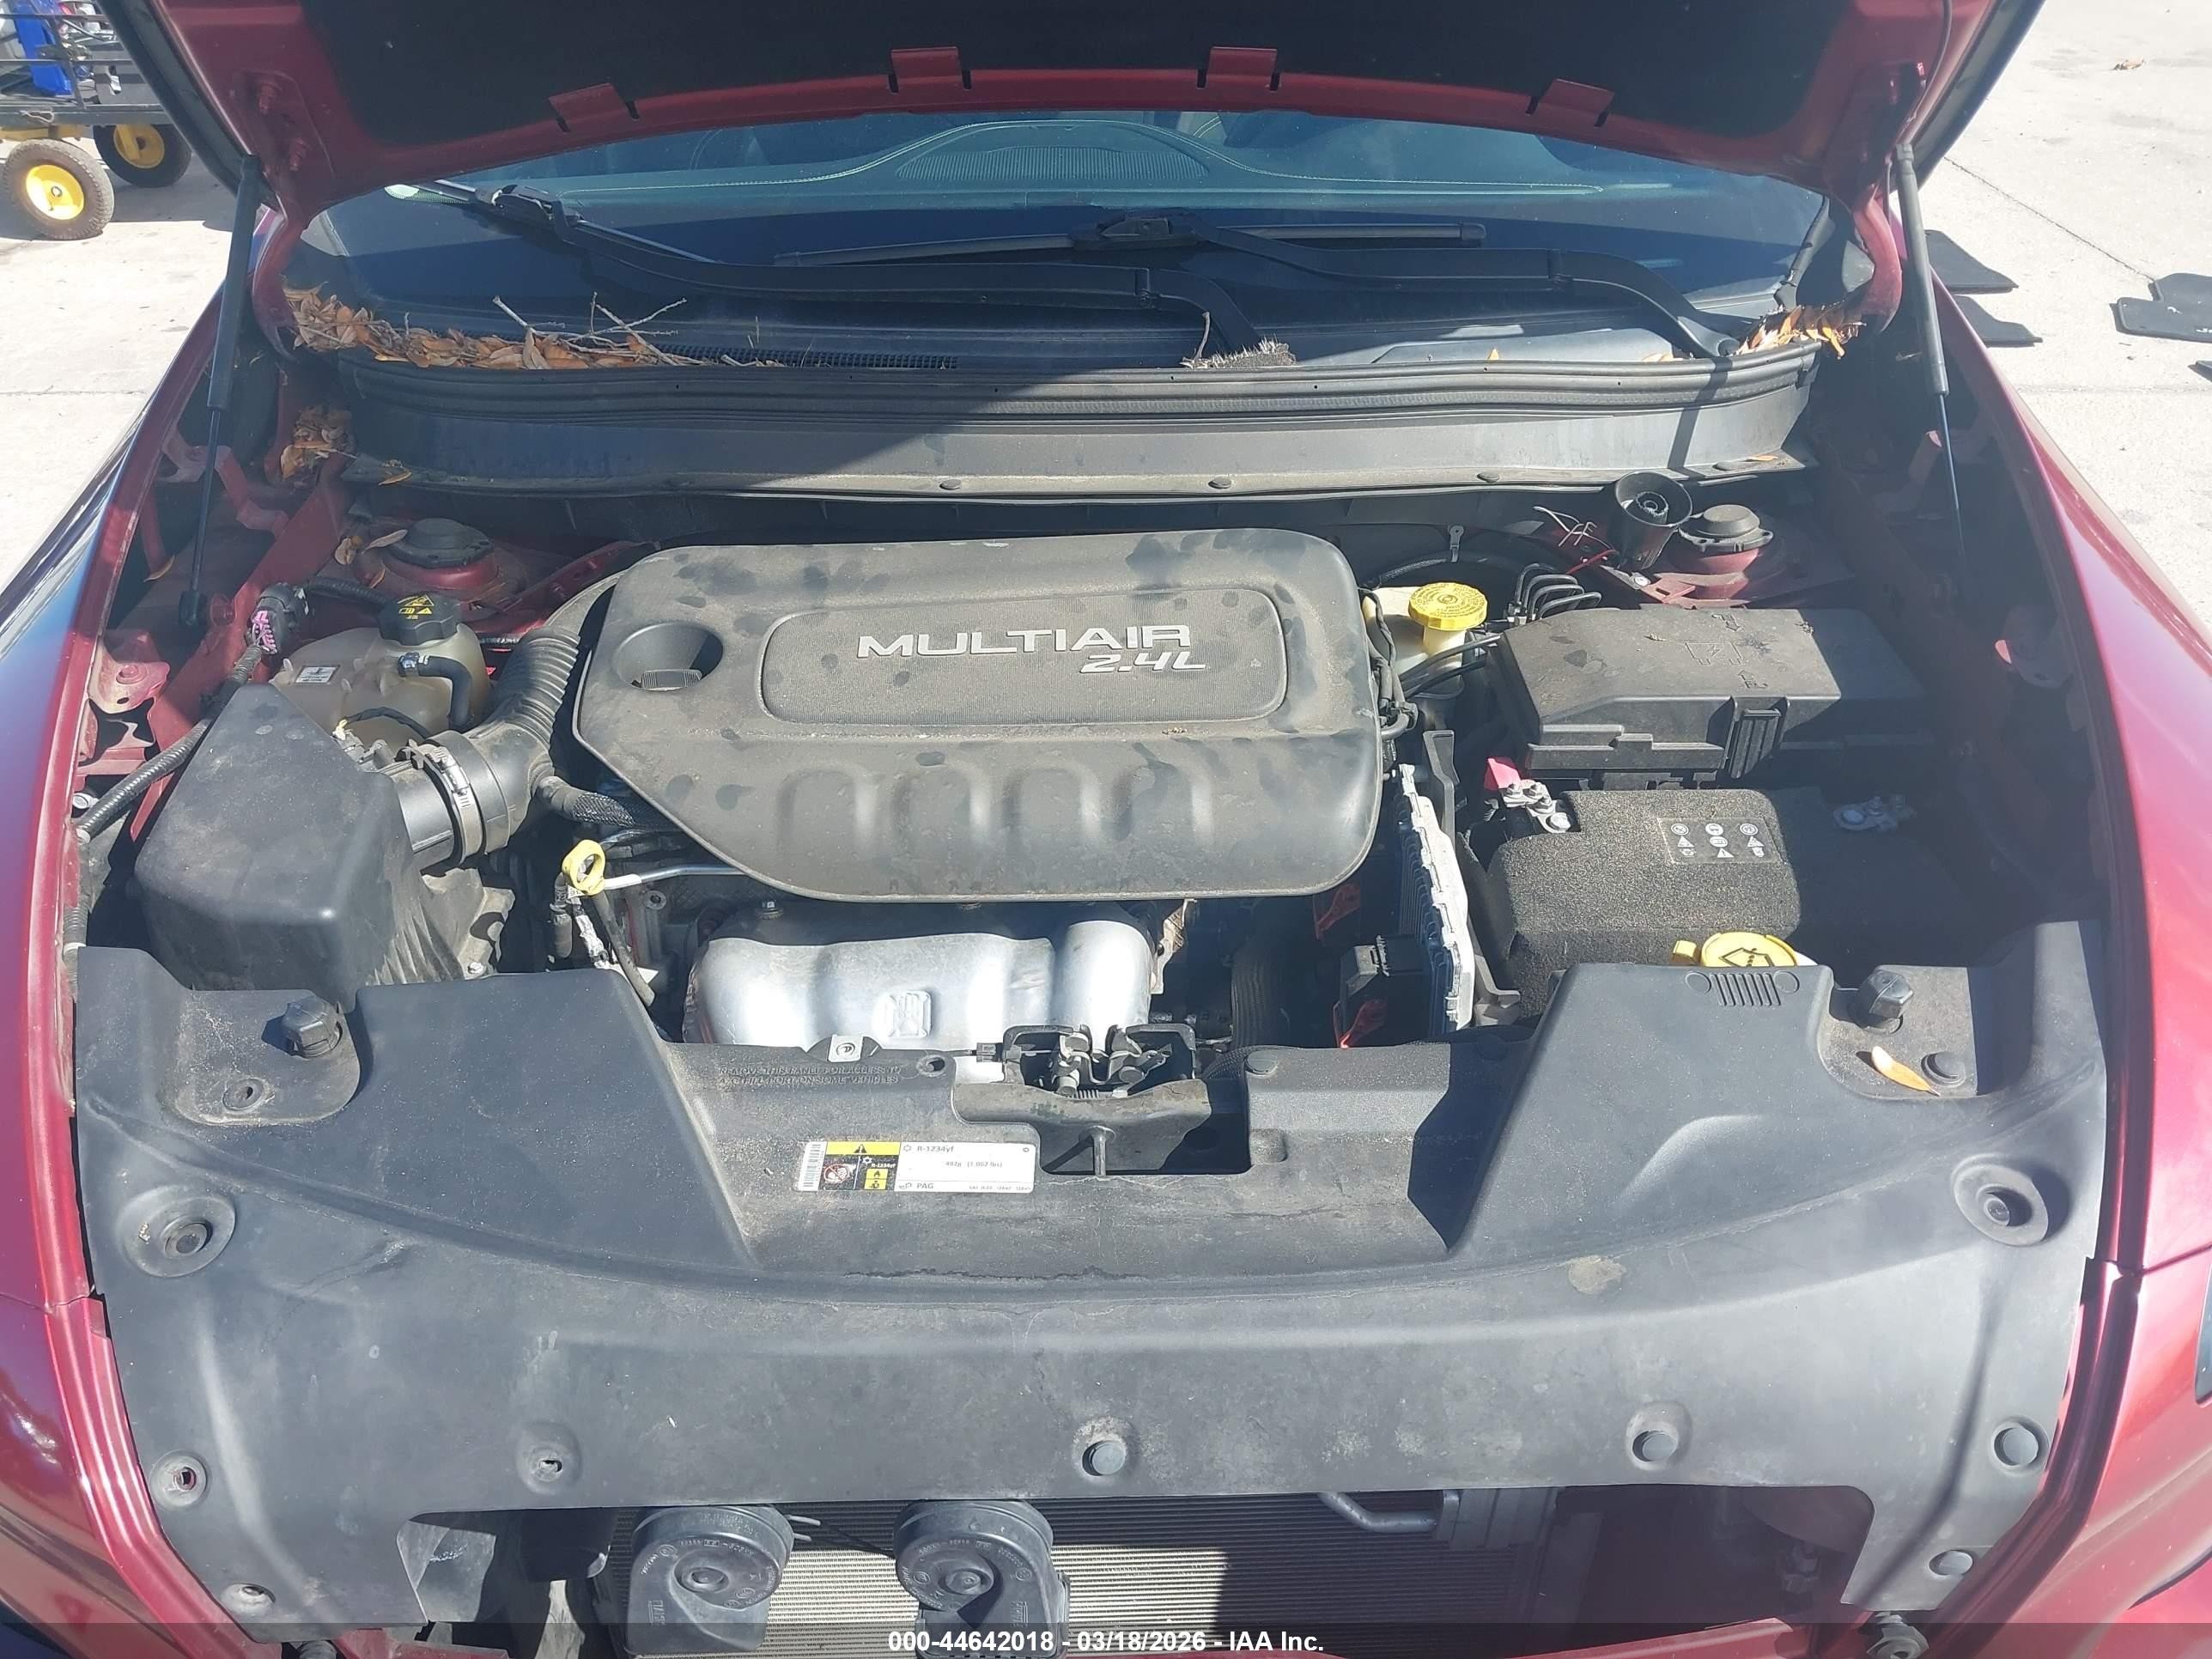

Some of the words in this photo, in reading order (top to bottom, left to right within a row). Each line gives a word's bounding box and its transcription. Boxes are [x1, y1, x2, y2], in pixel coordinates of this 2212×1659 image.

[858, 624, 1191, 658] MULTIAIR
[1080, 651, 1206, 672] 2.4L
[917, 1145, 955, 1153] R-1234yf
[916, 1182, 934, 1190] PAG
